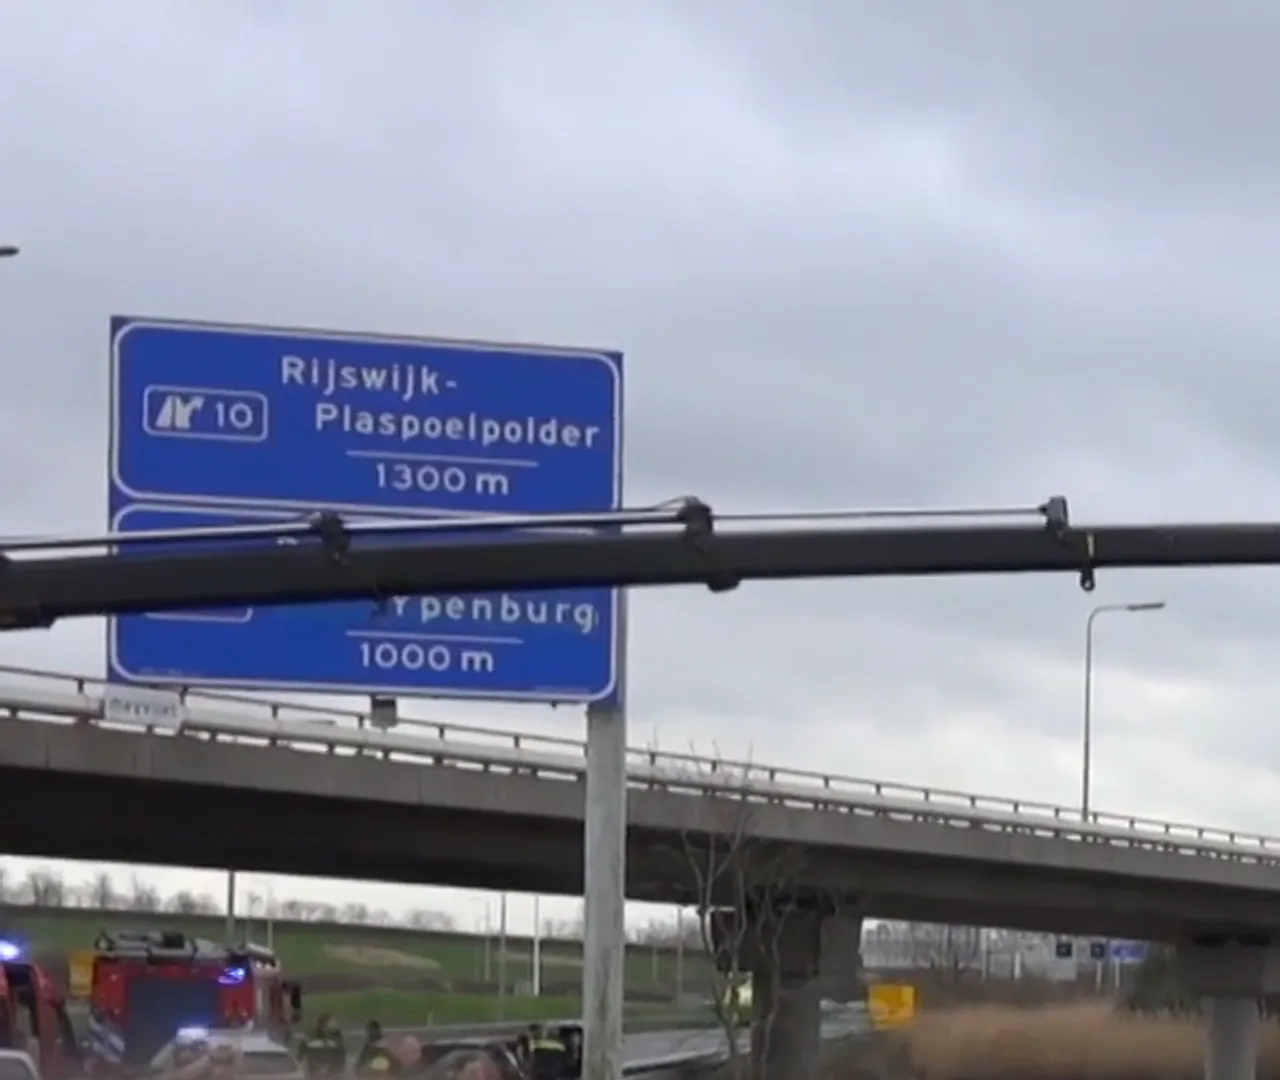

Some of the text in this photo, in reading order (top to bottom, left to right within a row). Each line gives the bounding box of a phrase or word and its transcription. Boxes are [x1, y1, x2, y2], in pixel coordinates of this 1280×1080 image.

[281, 355, 457, 402] Rijswijk-
[215, 401, 253, 430] 10
[315, 402, 600, 448] Plaspoelpolder
[376, 462, 509, 495] 1300 m
[359, 642, 495, 673] 1000 m
